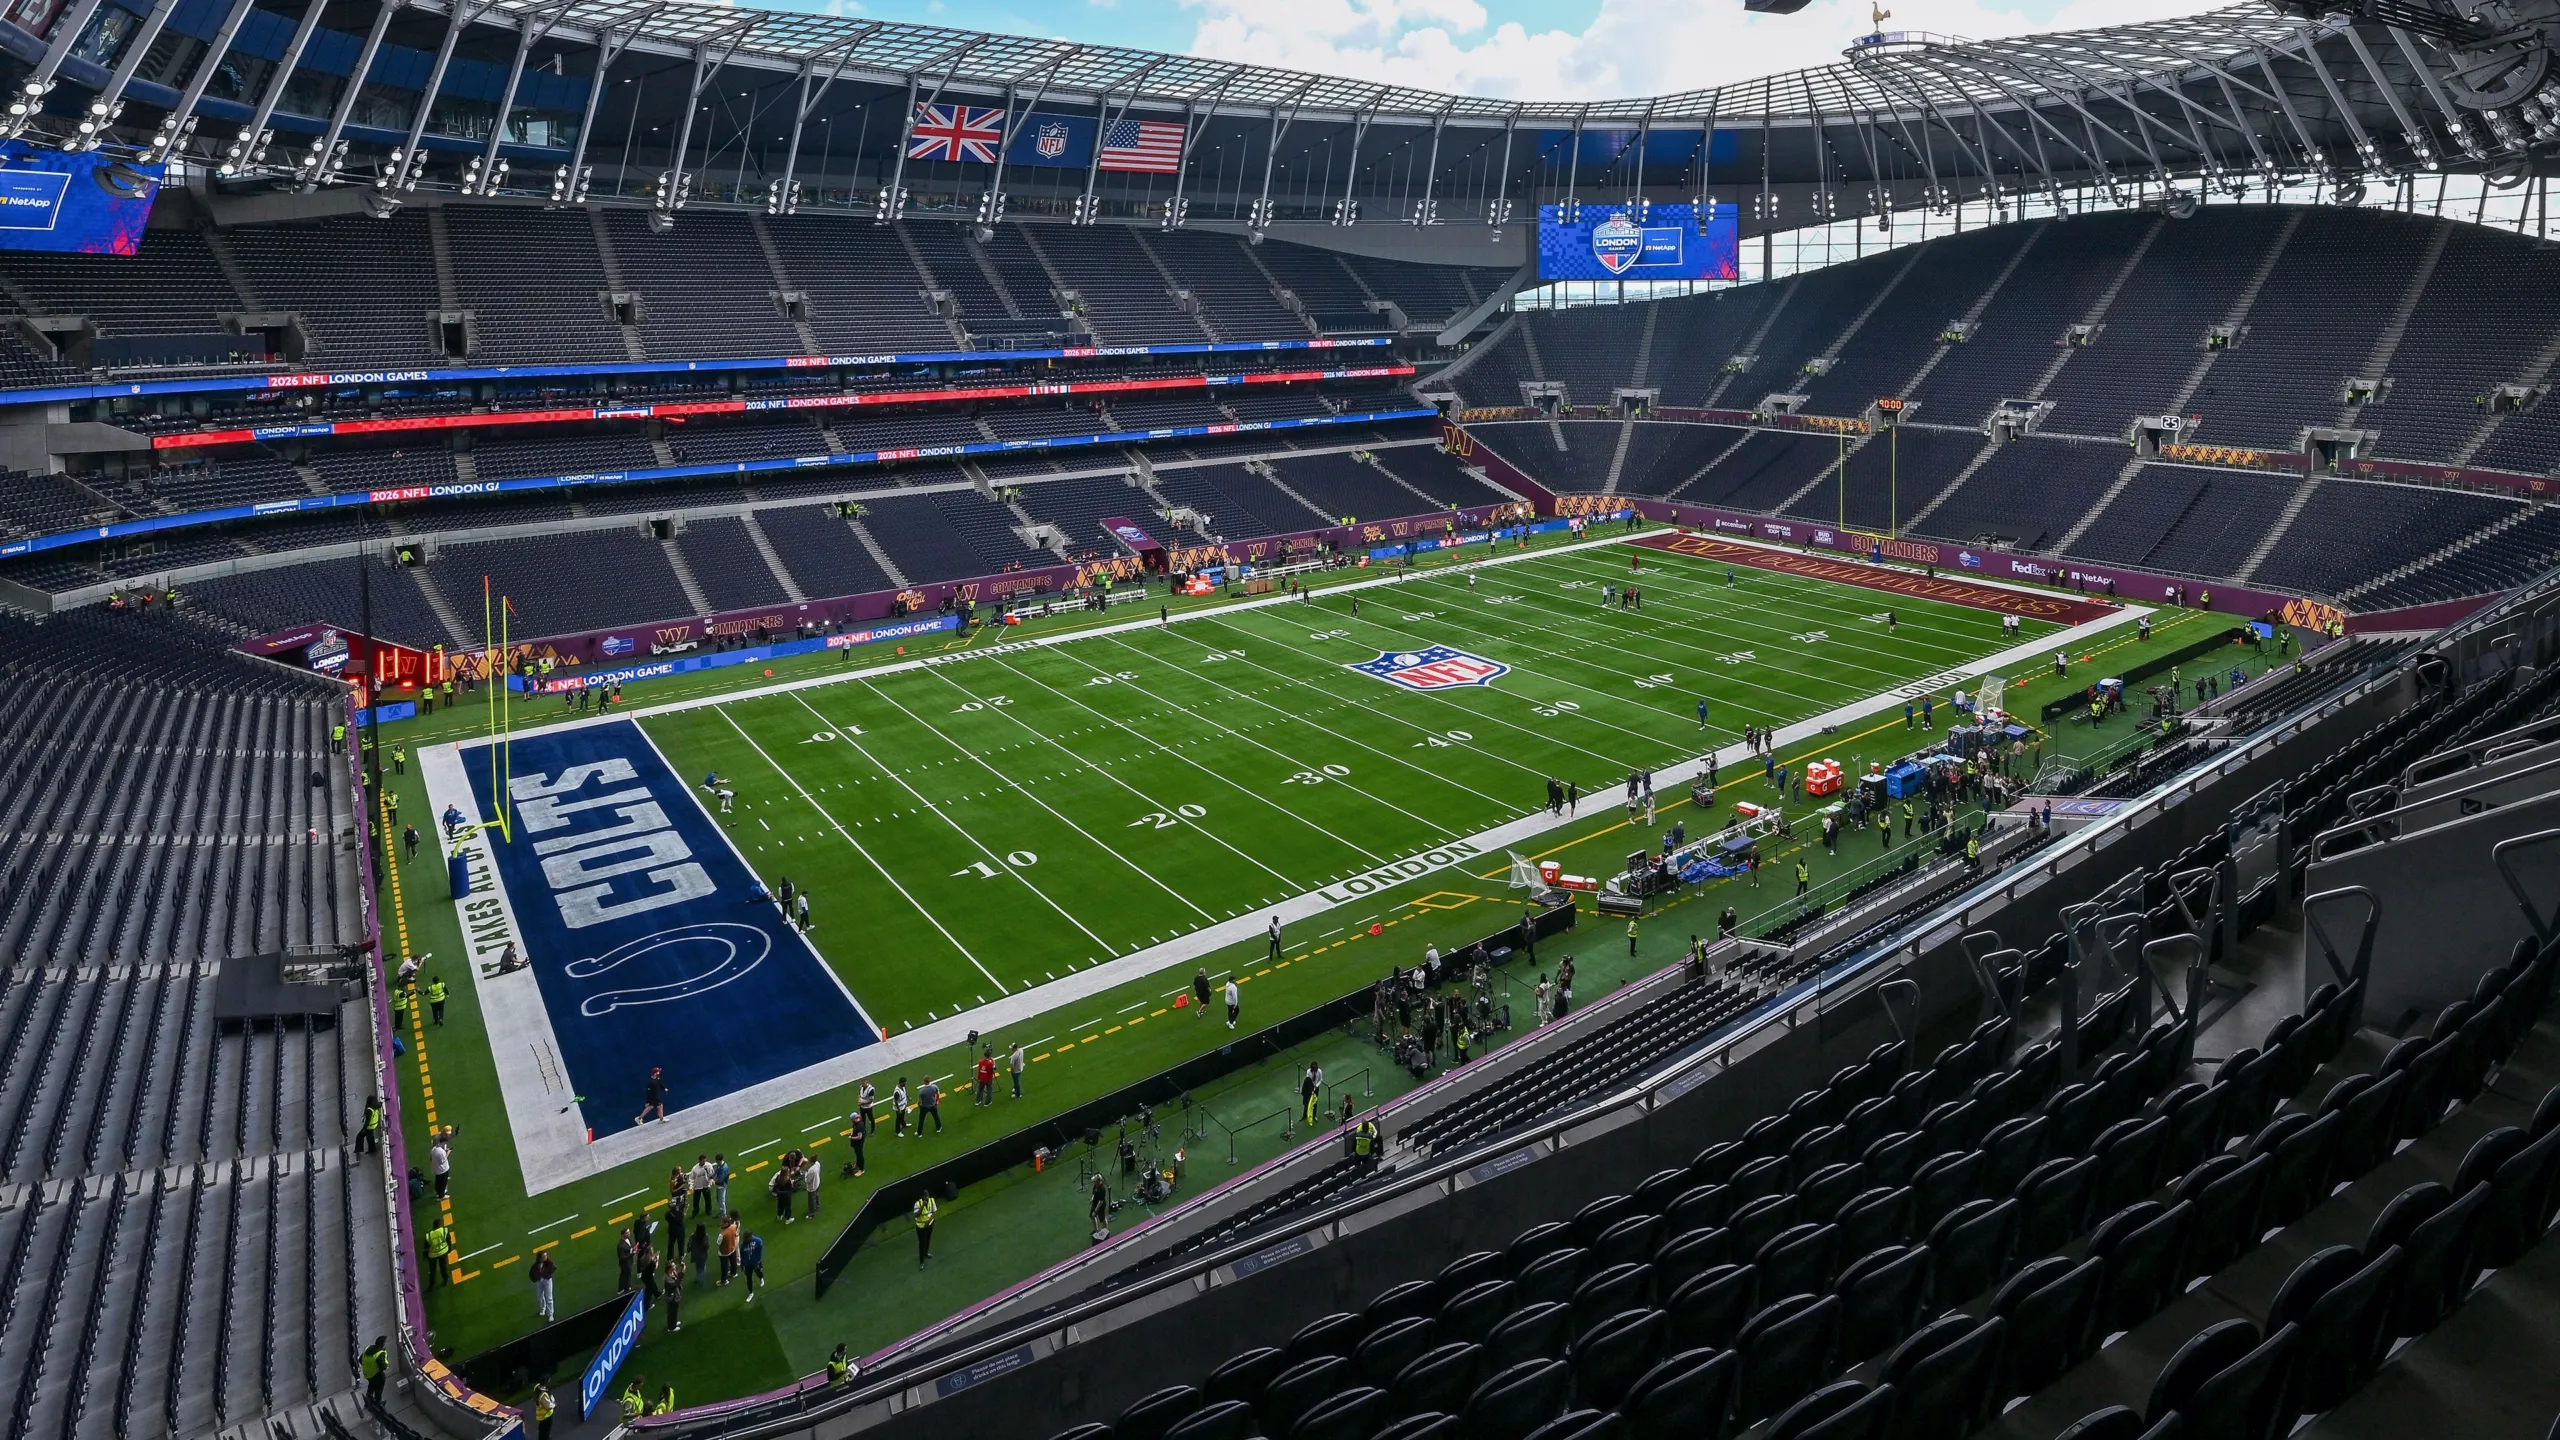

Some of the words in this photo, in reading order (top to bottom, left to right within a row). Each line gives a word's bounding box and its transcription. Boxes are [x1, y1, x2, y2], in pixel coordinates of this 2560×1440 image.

[1040, 137, 1062, 153] NFL
[8, 197, 51, 208] NetApp
[1596, 238, 1638, 247] LONDON
[1064, 349, 1080, 357] 2026
[1081, 348, 1095, 356] NFL
[1095, 347, 1125, 355] LONDON
[787, 358, 807, 367] 2026
[809, 357, 827, 366] NFL
[828, 356, 866, 365] LONDON
[867, 355, 896, 364] GAMES
[271, 377, 299, 387] 2026
[302, 375, 328, 385] NFL
[329, 372, 384, 384] LONDON
[387, 371, 428, 382] GAMES
[746, 401, 766, 410] 2026
[769, 399, 787, 408] NFL
[788, 398, 828, 407] LONDON
[829, 396, 860, 405] GAMES
[1878, 399, 1902, 409] 90:00
[2163, 417, 2178, 428] 25
[256, 426, 296, 435] LONDON
[878, 452, 897, 460] 2026
[899, 450, 916, 458] NFL
[917, 447, 953, 457] LONDON
[560, 474, 595, 482] LONDON
[372, 491, 399, 501] 2026
[403, 488, 427, 498] NFL
[429, 485, 483, 496] LONDON
[1721, 520, 1747, 530] accenture
[1764, 523, 1791, 531] AMERICAN
[1462, 534, 1485, 544] LONDON
[1768, 528, 1791, 537] EXPESS
[7, 545, 26, 553] NetApp
[2011, 560, 2046, 577] FedEx
[990, 575, 1052, 594] COMMANDERS
[1748, 555, 2071, 614] COMMANDERS
[828, 636, 852, 646] 202
[852, 632, 871, 643] NFL
[871, 625, 911, 639] LONDON
[1309, 629, 1351, 641] 50
[1789, 631, 1829, 643] 20
[920, 641, 1039, 665] LONDON
[1207, 649, 1246, 662] 40
[1714, 651, 1756, 665] 30
[313, 652, 349, 669] LONDON
[1091, 671, 1139, 685] 30
[1390, 659, 1497, 687] NFL
[558, 677, 583, 690] NFL
[1633, 674, 1674, 688] 40
[1888, 670, 1975, 700] LONDON
[961, 695, 1014, 712] 20
[1530, 700, 1580, 717] 50
[812, 724, 869, 742] 10
[1427, 730, 1473, 747] 40
[1292, 764, 1350, 785] 30
[1836, 777, 1842, 786] G
[1822, 782, 1828, 792] G
[1141, 803, 1207, 829] 20
[508, 757, 718, 929] COLTS
[967, 850, 1038, 880] 10
[1317, 841, 1482, 904] LONDON
[1545, 870, 1553, 879] G
[464, 898, 512, 956] TAKES
[1260, 1252, 1275, 1260] Please
[582, 1300, 643, 1412] LONDON
[971, 1365, 989, 1374] Please
[996, 1358, 1005, 1366] not
[1005, 1353, 1018, 1362] place
[973, 1371, 989, 1380] drinks
[1006, 1358, 1021, 1367] ledge
